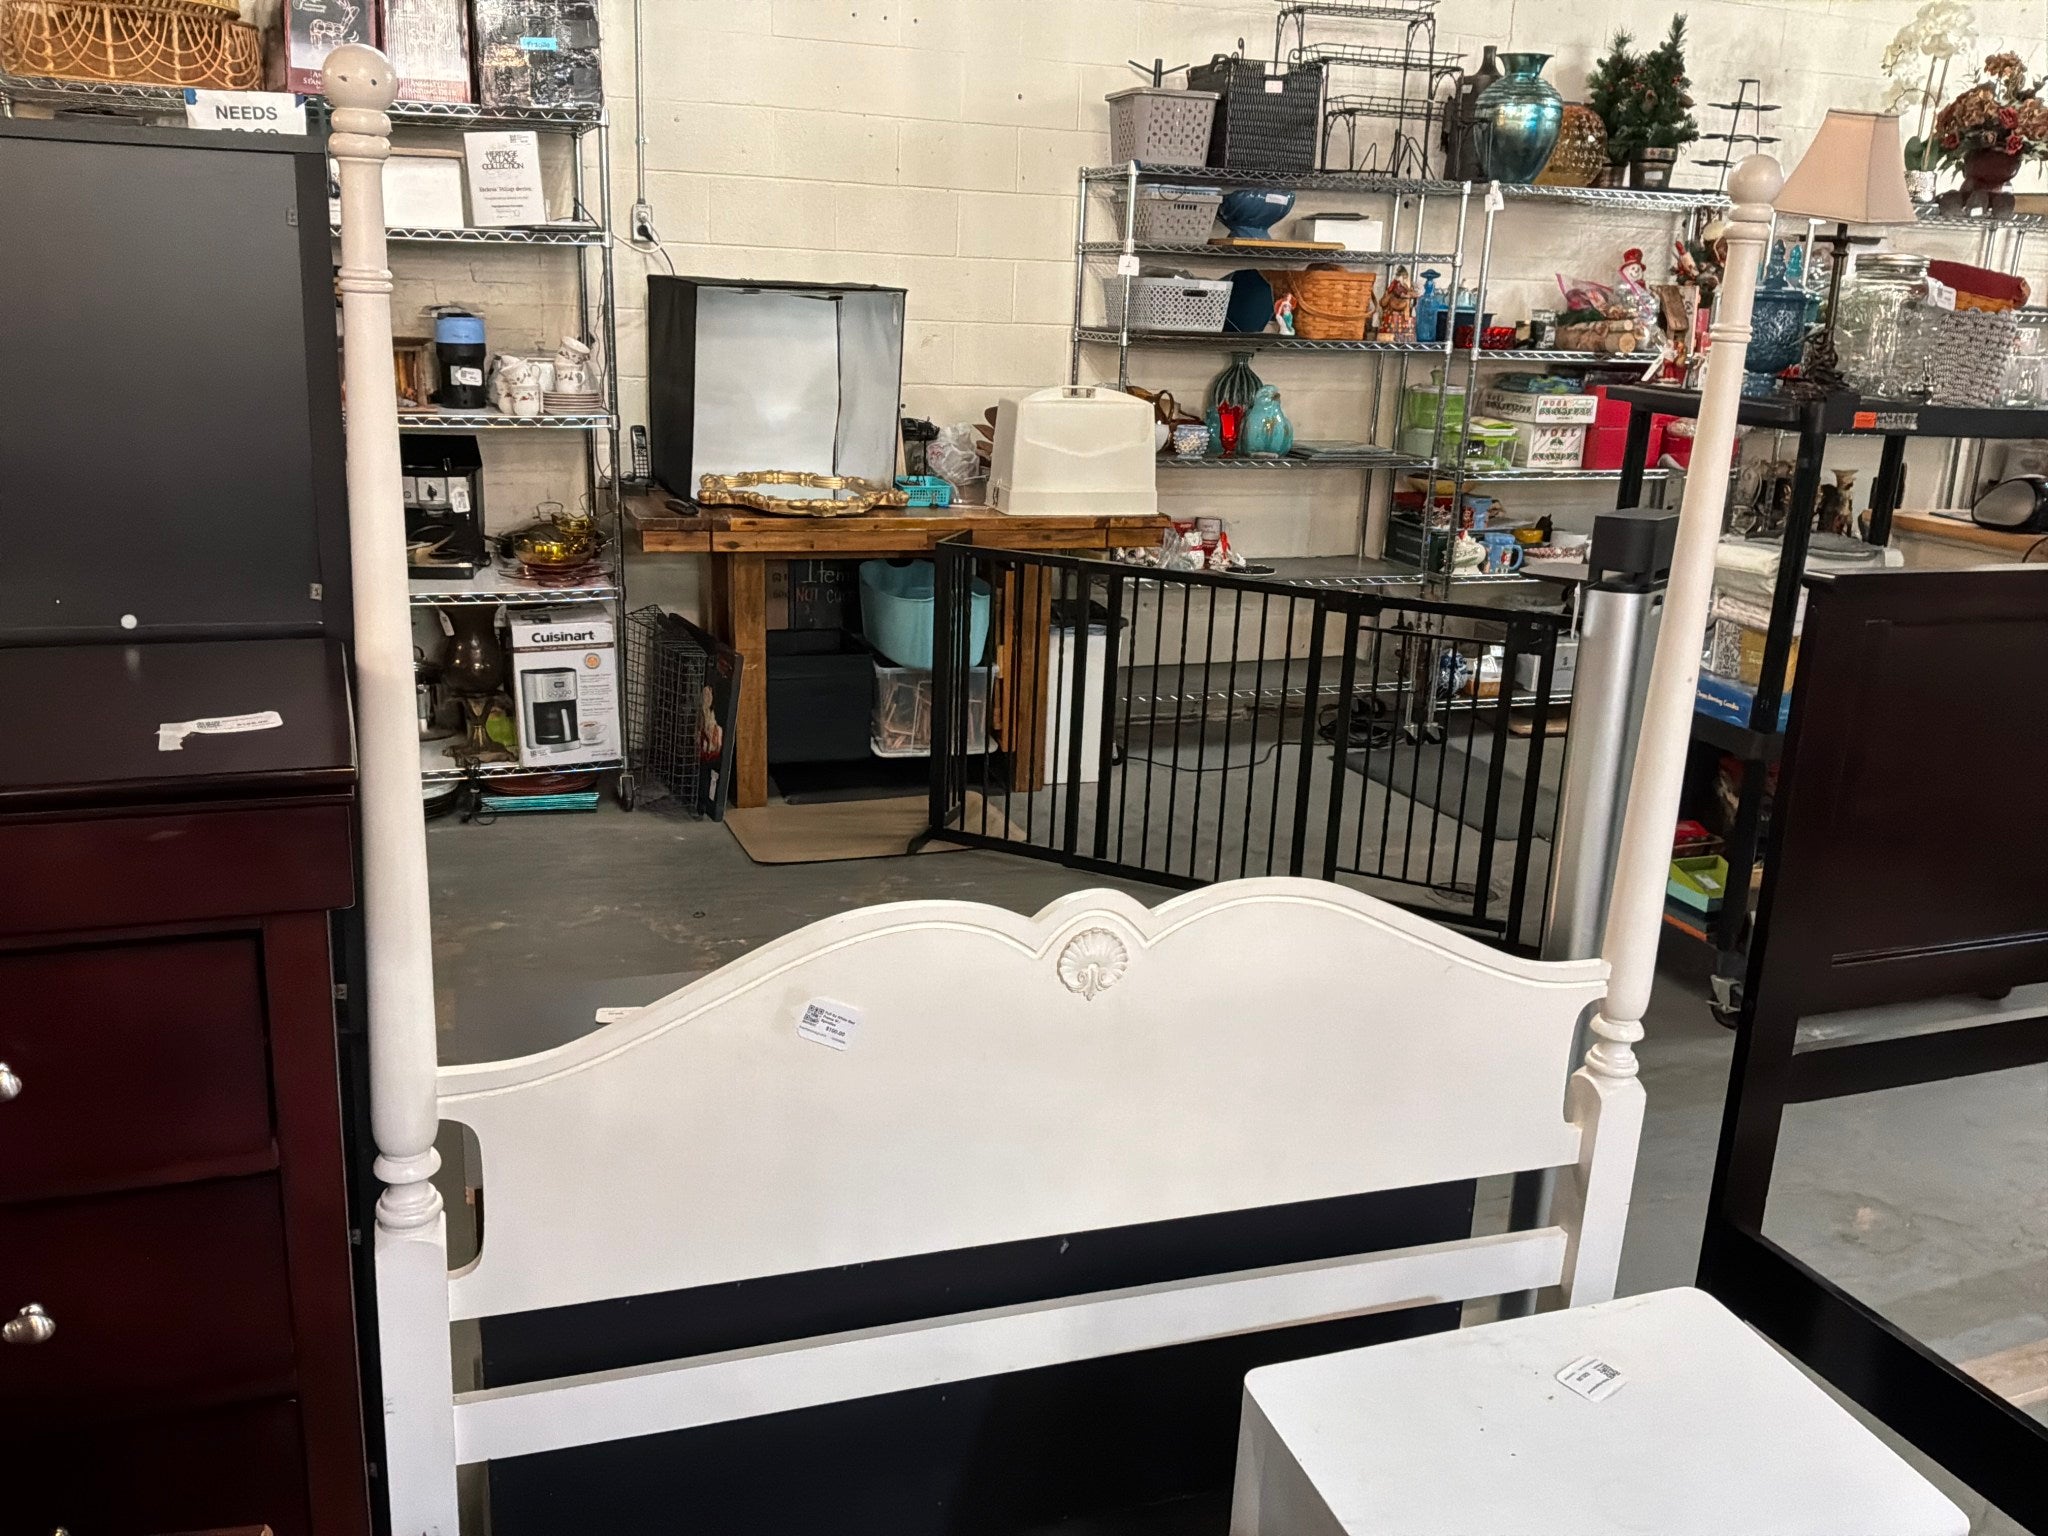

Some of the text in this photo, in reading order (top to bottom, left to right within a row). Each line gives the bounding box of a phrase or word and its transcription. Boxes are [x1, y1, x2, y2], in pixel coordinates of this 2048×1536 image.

[215, 105, 278, 121] NEEDS
[482, 163, 524, 171] COLLECTION
[531, 630, 595, 643] Cuisinart
